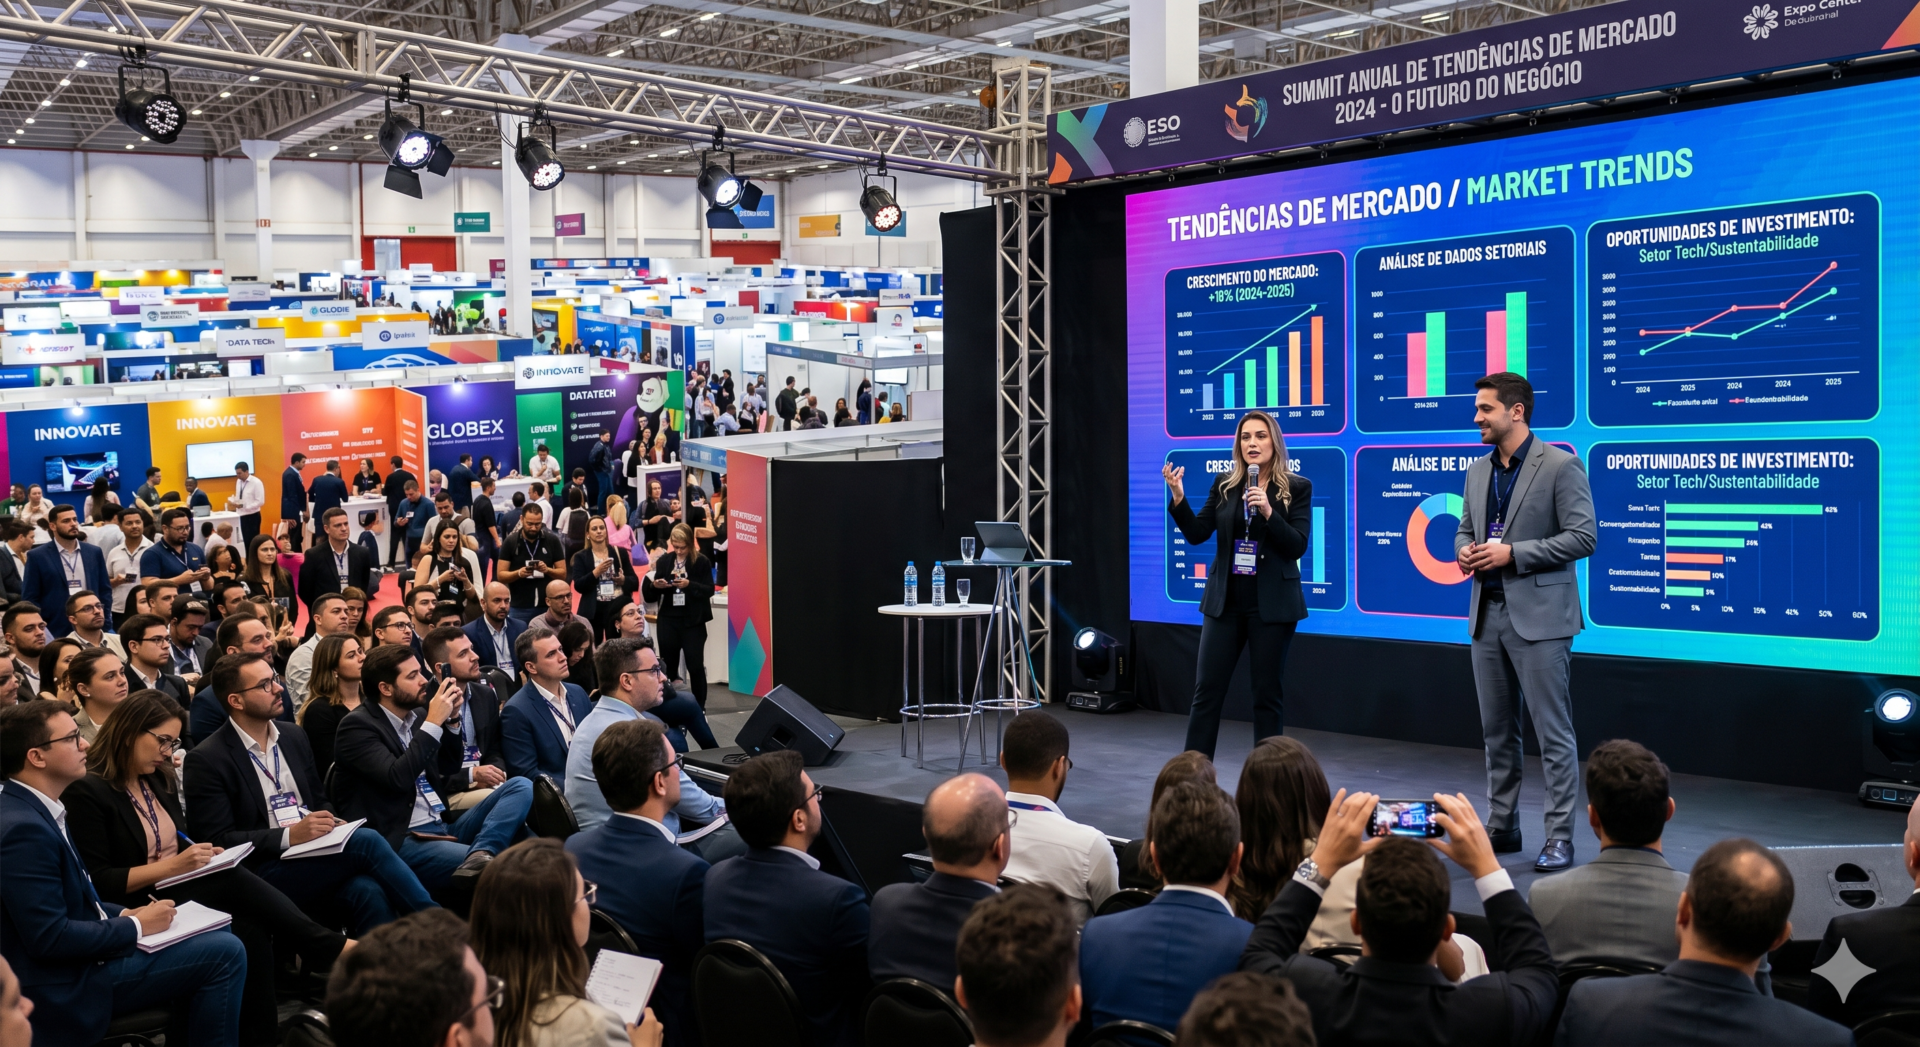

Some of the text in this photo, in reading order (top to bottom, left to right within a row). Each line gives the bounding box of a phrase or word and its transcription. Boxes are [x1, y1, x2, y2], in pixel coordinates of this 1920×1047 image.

[1784, 0, 1862, 16] Expo Cent
[1283, 11, 1676, 106] SUMMIT ANUAL DE TENDÊNCIAS DE MERCADO
[1335, 97, 1376, 125] 2024
[1391, 92, 1402, 115] O
[1407, 80, 1470, 112] FUTURO
[1476, 75, 1499, 100] DO
[1504, 60, 1582, 96] NEGÓCIO
[1148, 115, 1180, 135] ESO
[1167, 147, 1694, 242] TENDÊNCIAS DE MERCADO / MARKET TRENDS
[1606, 207, 1855, 248] OPORTUNIDADES DE INVESTIMENTO:
[1379, 240, 1547, 271] ANÁLISE DE DADOS SETORIAIS
[1639, 232, 1819, 263] Setor Tech/Sustentabilidade
[1187, 264, 1319, 289] CRESCIMENTO DO MERCADO:
[1235, 282, 1295, 302] (2024-2025)
[1727, 382, 1743, 390] 2024
[1775, 380, 1791, 388] 2024
[1825, 378, 1842, 386] 2025
[569, 389, 616, 401] DATATECH
[177, 413, 257, 430] INNOVATE
[427, 419, 504, 439] GLOBEX
[35, 423, 121, 441] INNOVATE
[1392, 453, 1439, 472] ANÁLISE
[1441, 457, 1457, 471] DE
[1606, 451, 1855, 470] OPORTUNIDADES DE INVESTIMENTO:
[1637, 473, 1820, 490] Setor Tech/Sustentabilidade
